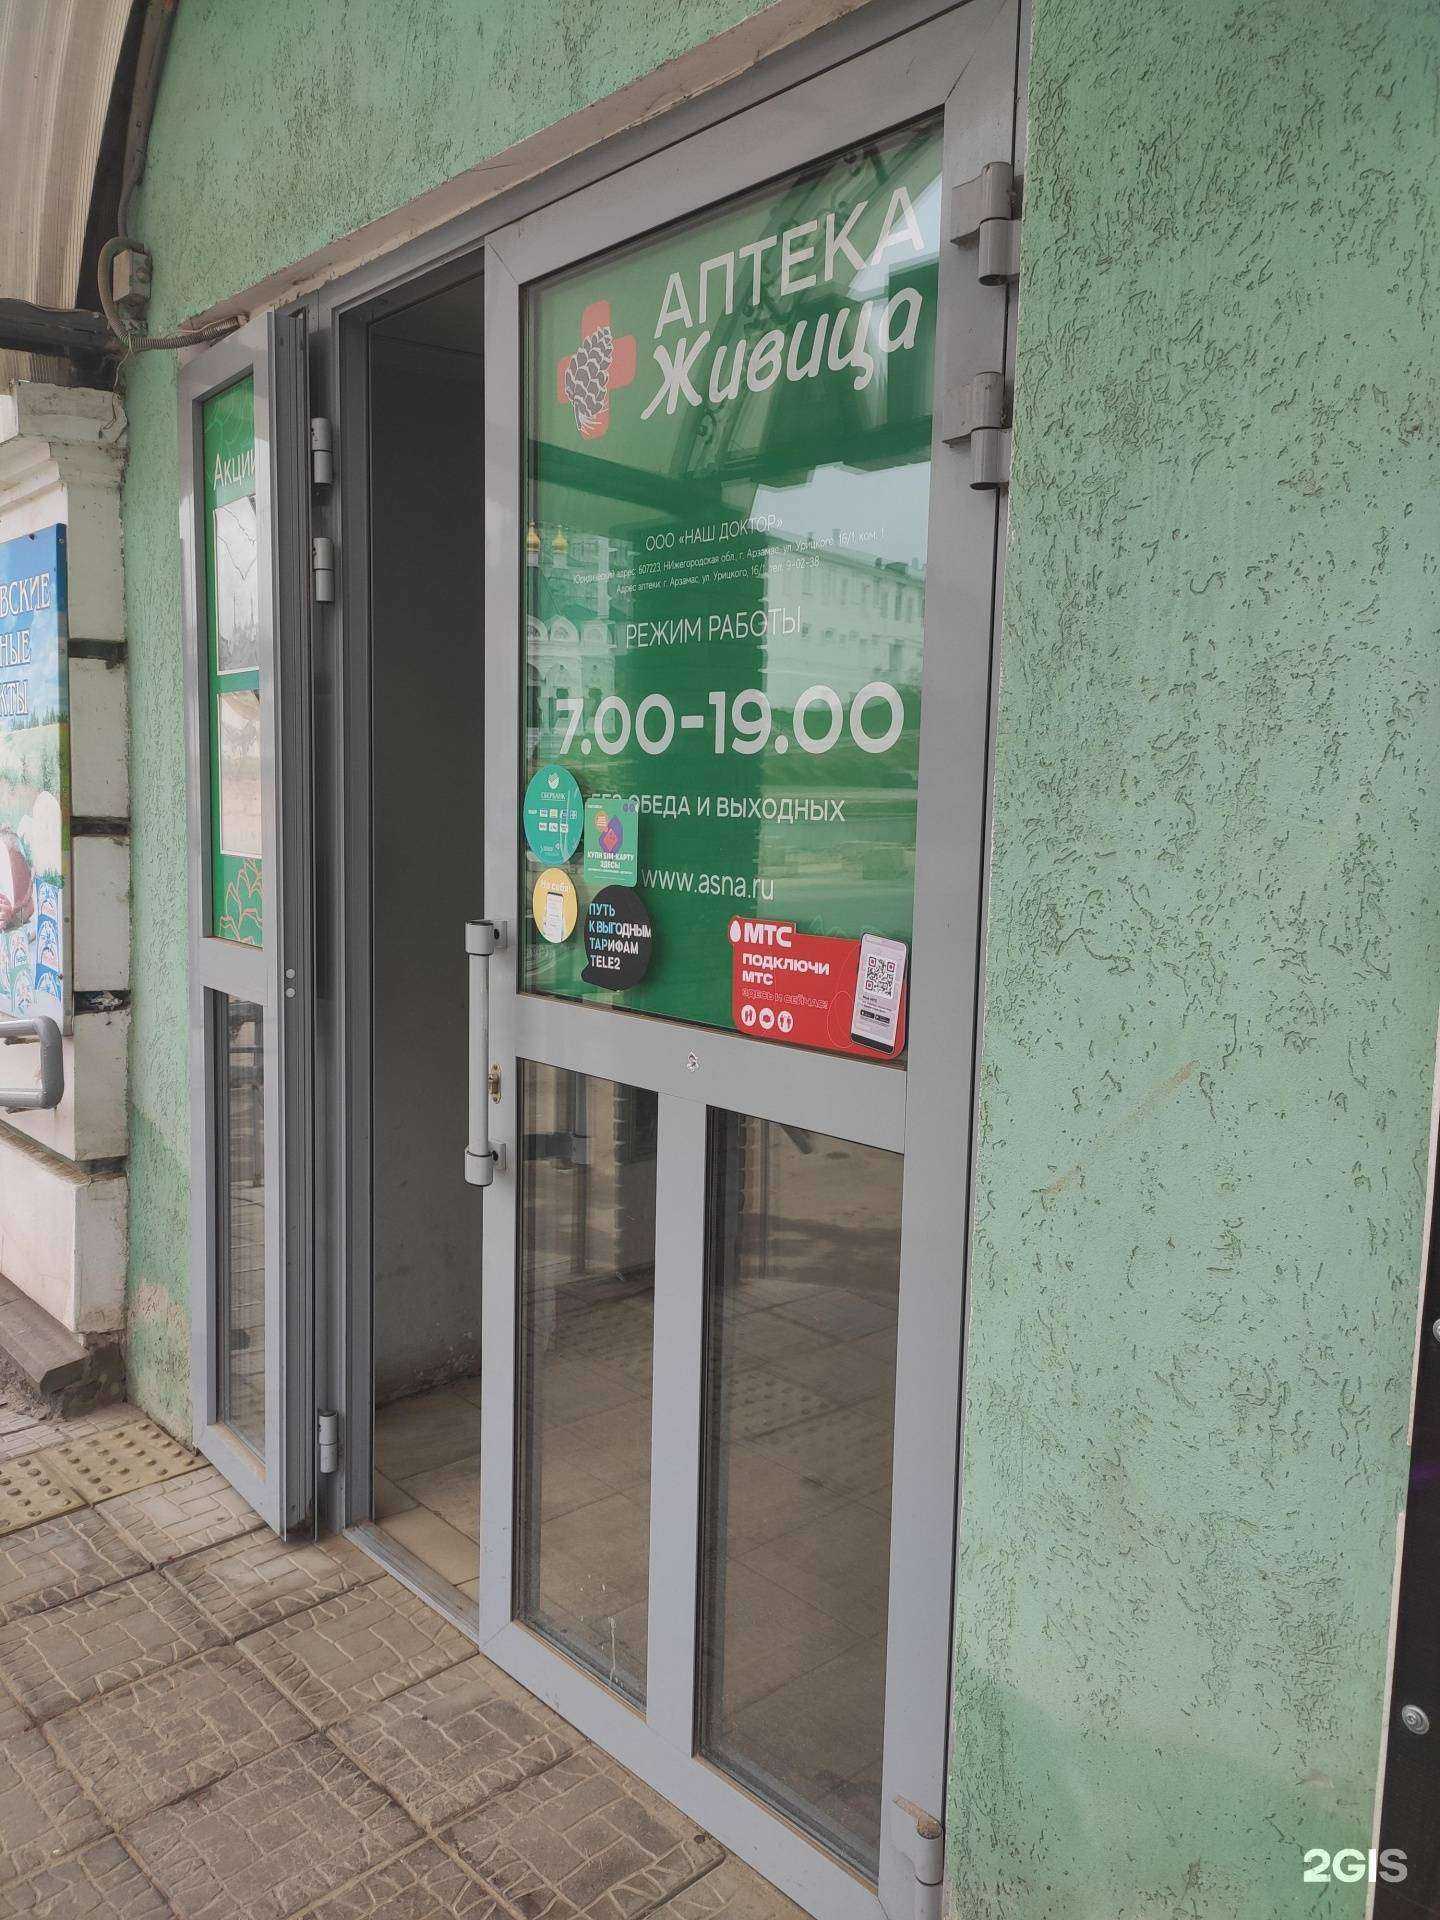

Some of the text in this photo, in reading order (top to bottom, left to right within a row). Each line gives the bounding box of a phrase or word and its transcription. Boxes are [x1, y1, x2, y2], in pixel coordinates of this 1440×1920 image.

[654, 186, 925, 339] АПТЕКА
[640, 286, 923, 420] Живица
[645, 514, 783, 551] ООО «НАШ ДОКТОР»
[626, 605, 801, 648] РЕЖИМ РАБОТЫ
[556, 681, 904, 755] 7.00-19.00
[697, 797, 711, 817] И
[716, 797, 846, 824] ВЫХОДНЫХ
[641, 868, 774, 900] www.asna.ru
[589, 903, 616, 917] ПУТЬ
[589, 920, 652, 939] К ВЫГОДНЫМ
[743, 922, 792, 948] МТС
[589, 937, 639, 955] ТАРИФАМ
[590, 955, 620, 970] TELE2
[742, 953, 830, 976] ПОДКЛЮЧИ
[742, 970, 774, 986] МТС
